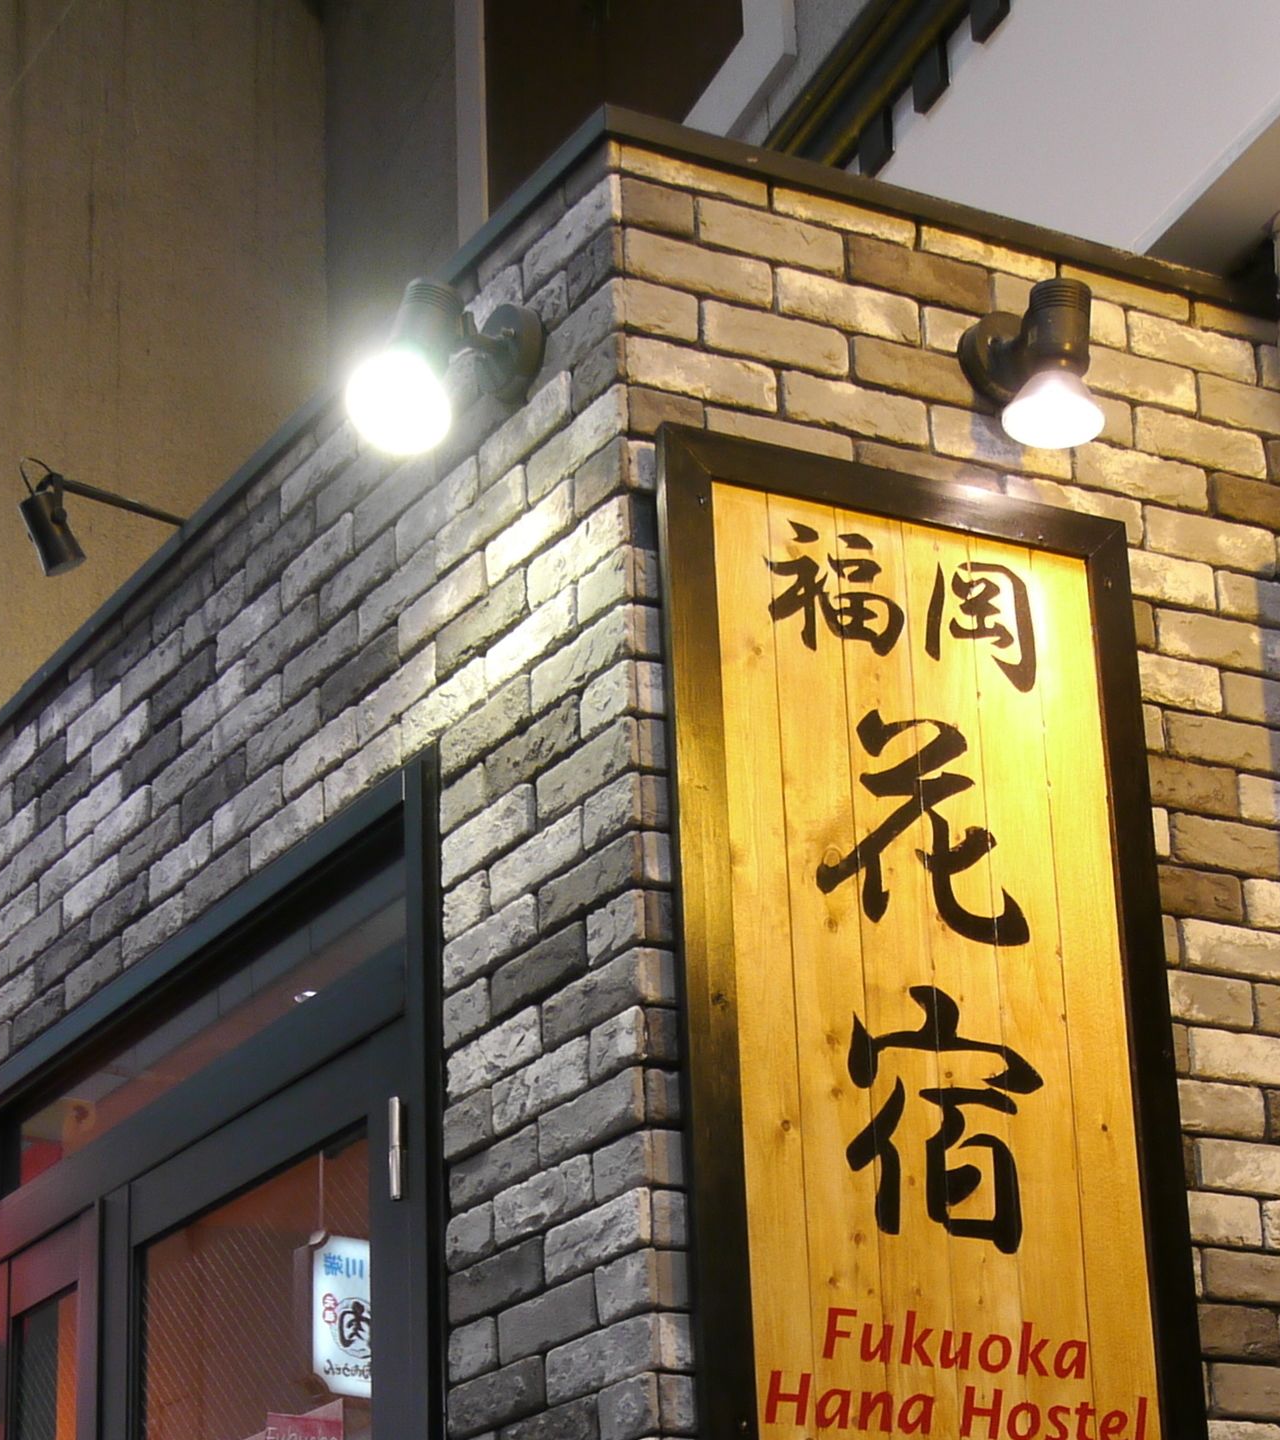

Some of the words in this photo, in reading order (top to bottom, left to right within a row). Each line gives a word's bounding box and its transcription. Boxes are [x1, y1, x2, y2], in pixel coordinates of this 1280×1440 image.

[762, 518, 1037, 692] 福岡
[821, 1306, 1089, 1382] Fukuoka
[763, 1370, 936, 1437] Hana
